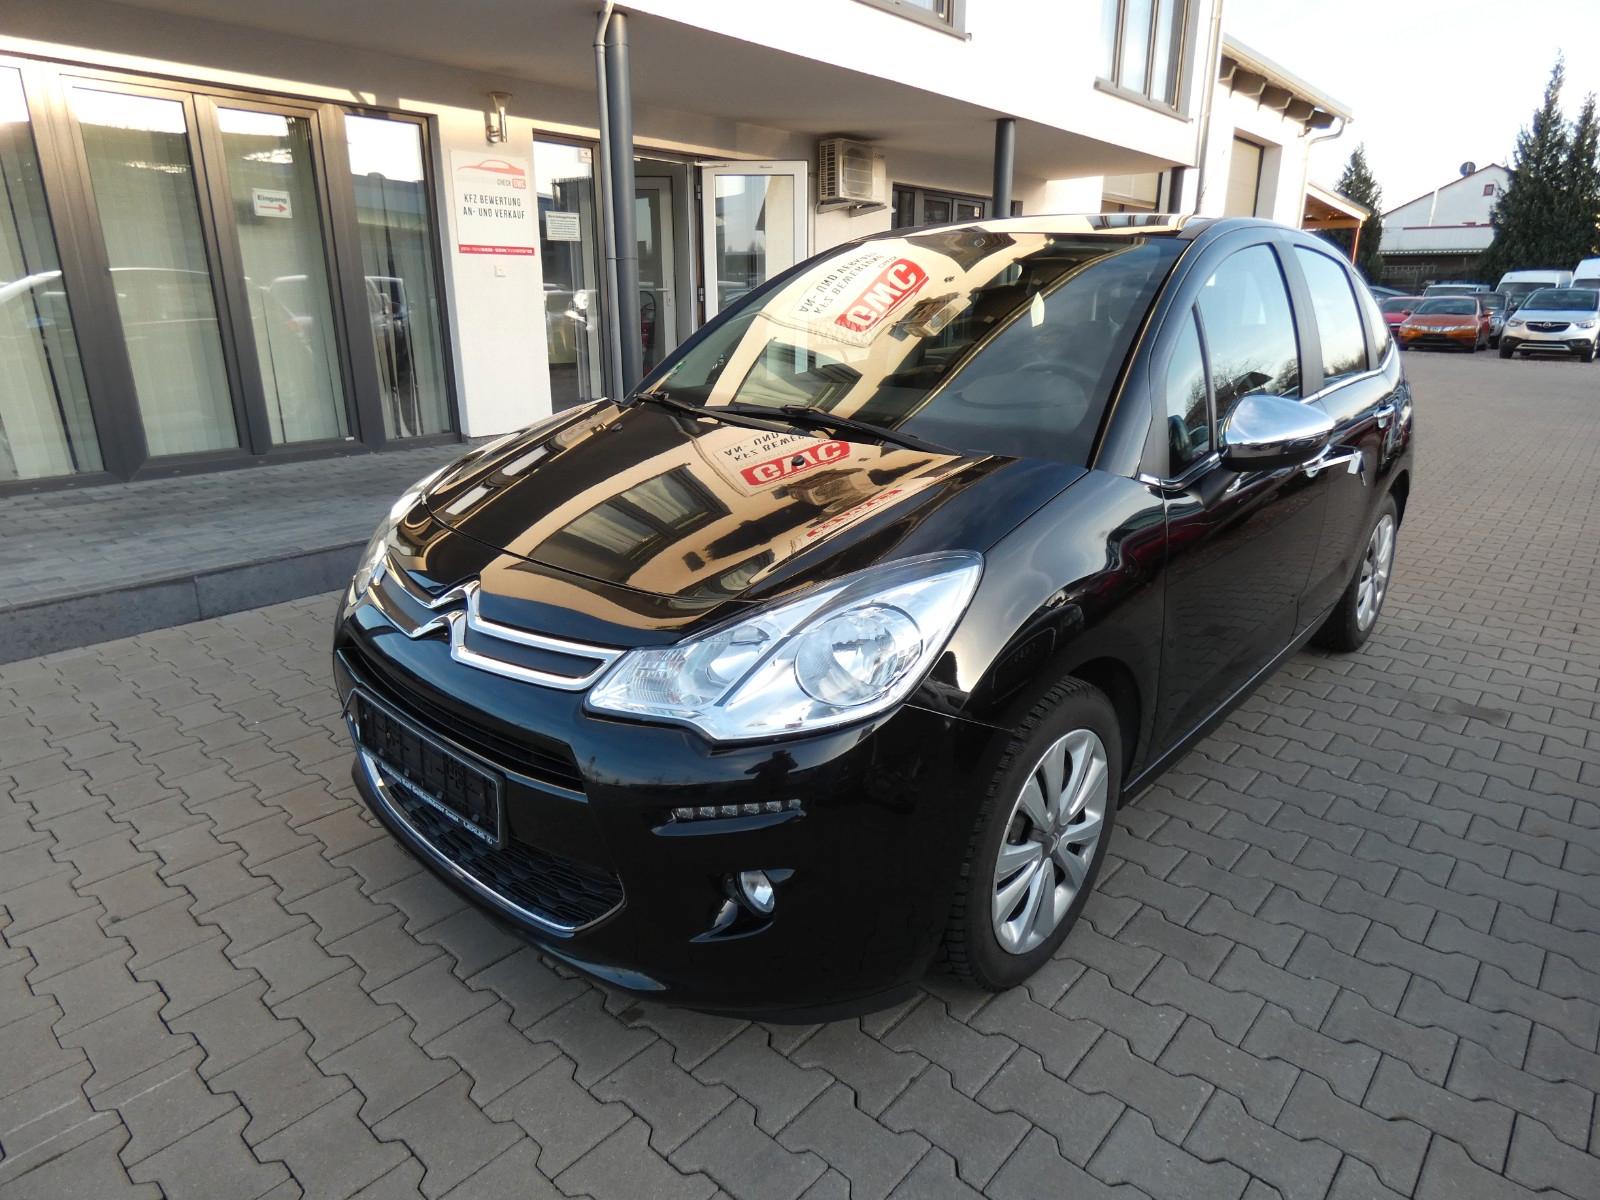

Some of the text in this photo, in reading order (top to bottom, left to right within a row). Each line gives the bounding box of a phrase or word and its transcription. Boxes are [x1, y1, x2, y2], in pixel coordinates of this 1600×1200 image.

[257, 194, 287, 204] Eingang
[463, 193, 521, 207] KFZ BEWERTUNG
[463, 206, 525, 220] AN- UND VERKAUF
